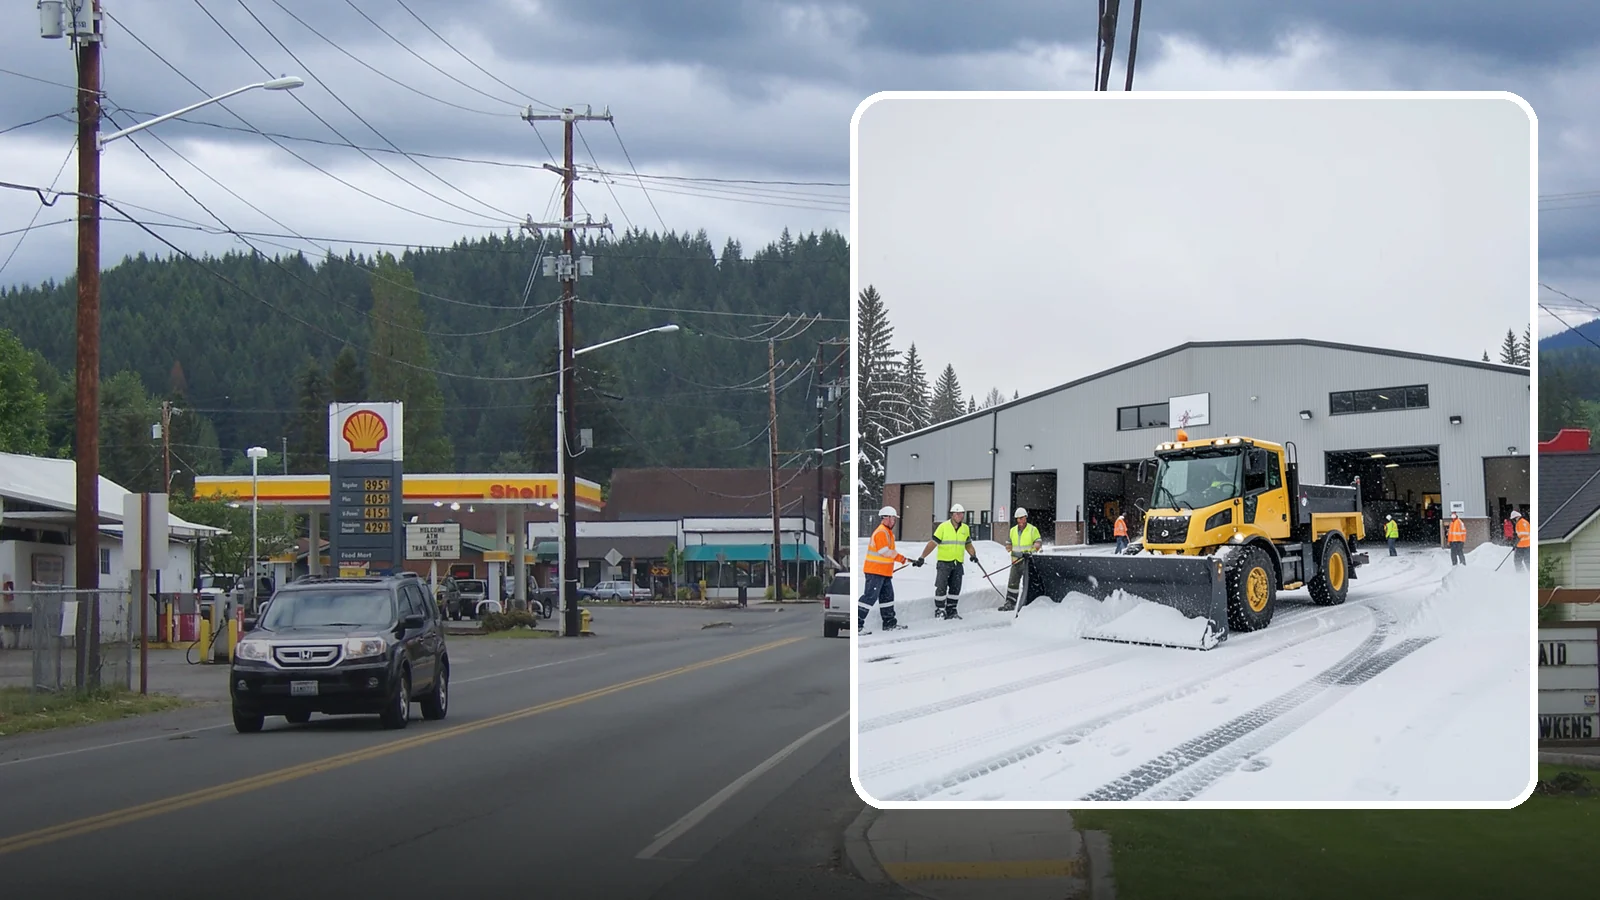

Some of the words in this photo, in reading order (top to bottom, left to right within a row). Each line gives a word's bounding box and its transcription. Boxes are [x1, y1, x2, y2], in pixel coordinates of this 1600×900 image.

[365, 480, 384, 490] 395
[490, 484, 547, 499] Shell
[365, 494, 384, 504] 405
[365, 508, 383, 518] 415
[365, 522, 383, 532] 429
[1538, 642, 1567, 666] AID
[1538, 715, 1592, 739] WKENS
